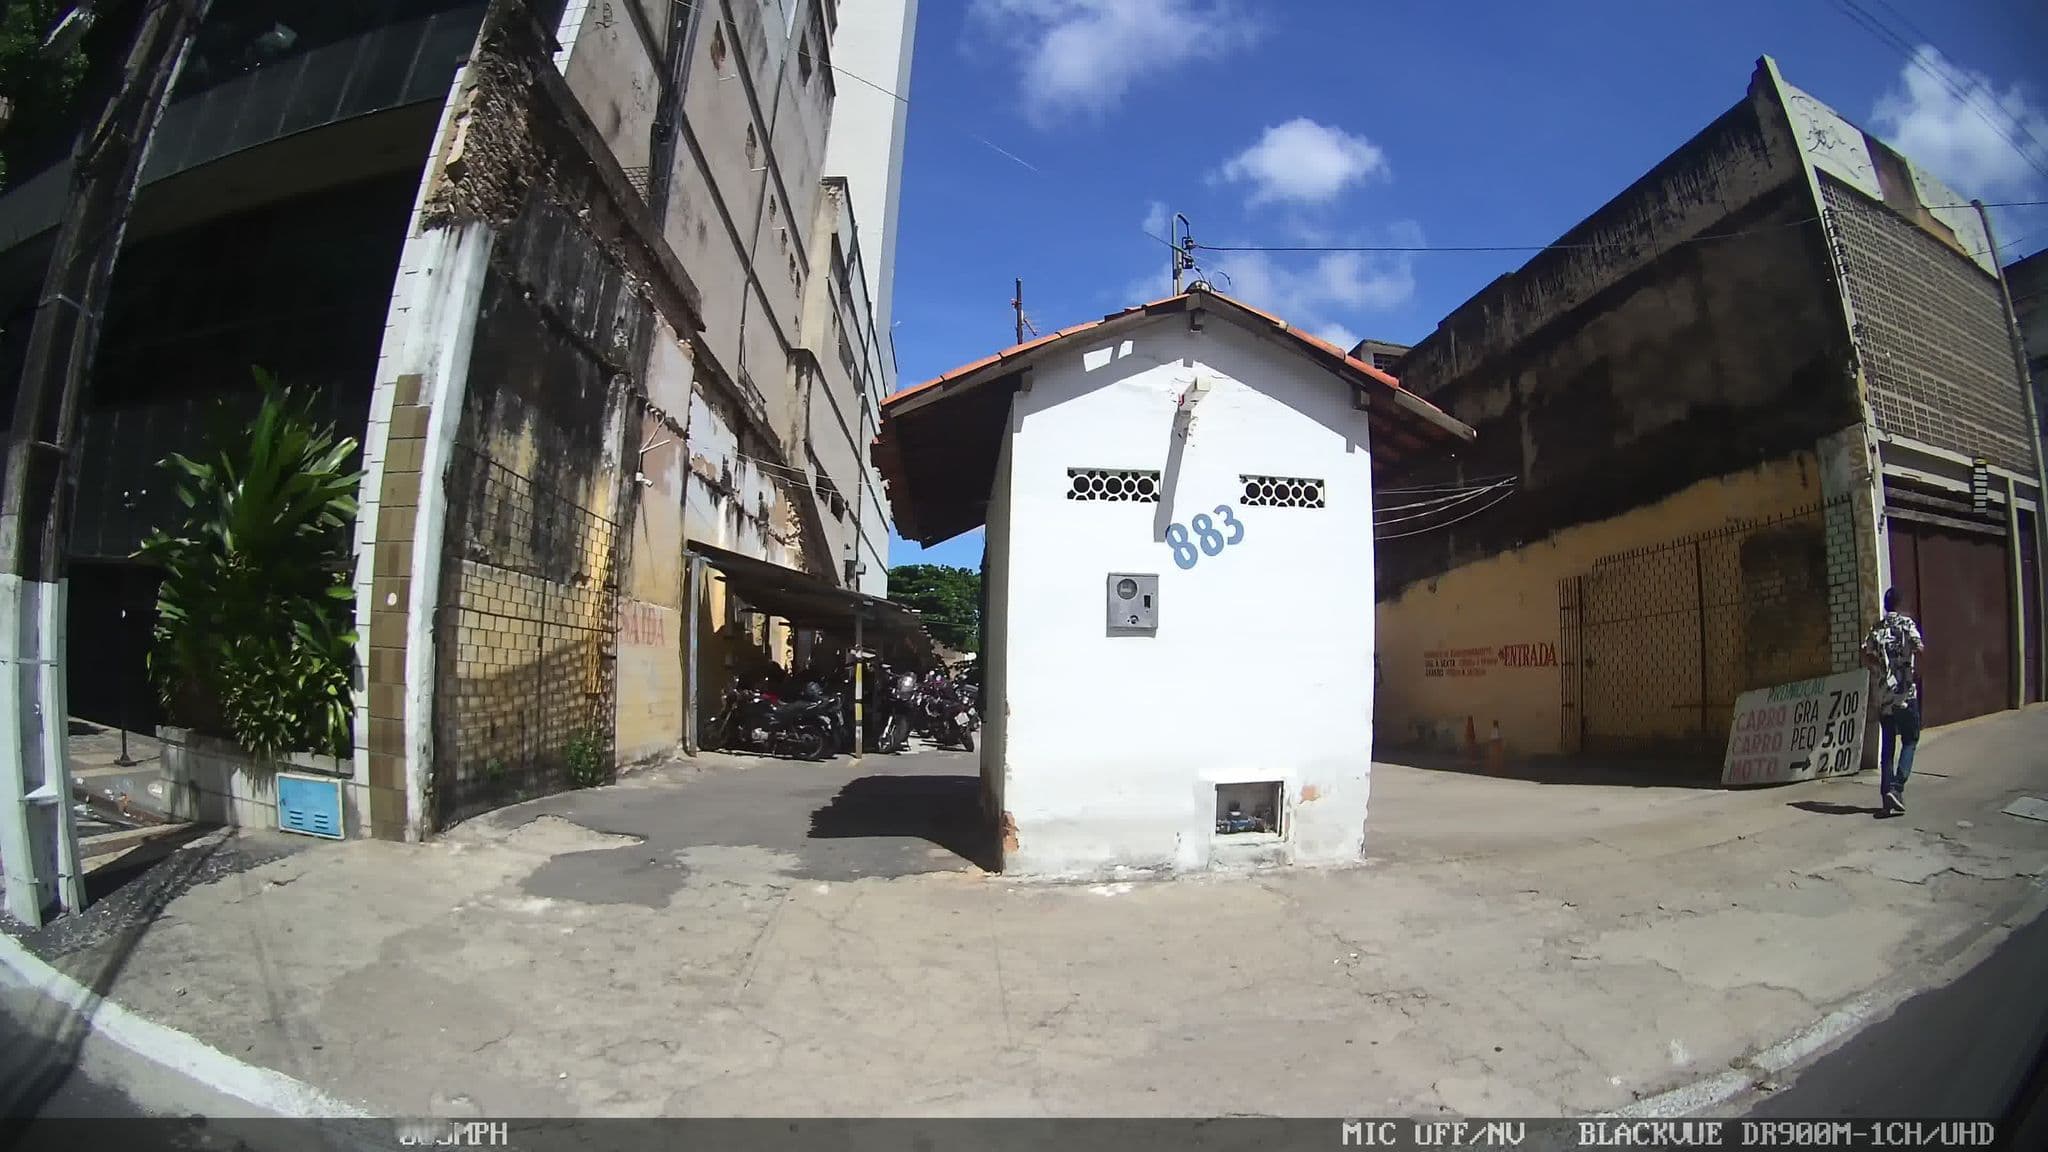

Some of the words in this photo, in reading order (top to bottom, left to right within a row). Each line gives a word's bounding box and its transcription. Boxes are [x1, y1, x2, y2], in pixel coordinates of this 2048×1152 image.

[1165, 504, 1244, 570] 883
[1504, 641, 1558, 667] ENTRADA
[1736, 704, 1787, 732] CARRO
[1794, 700, 1819, 724] GRA
[1791, 726, 1817, 751] PEQ
